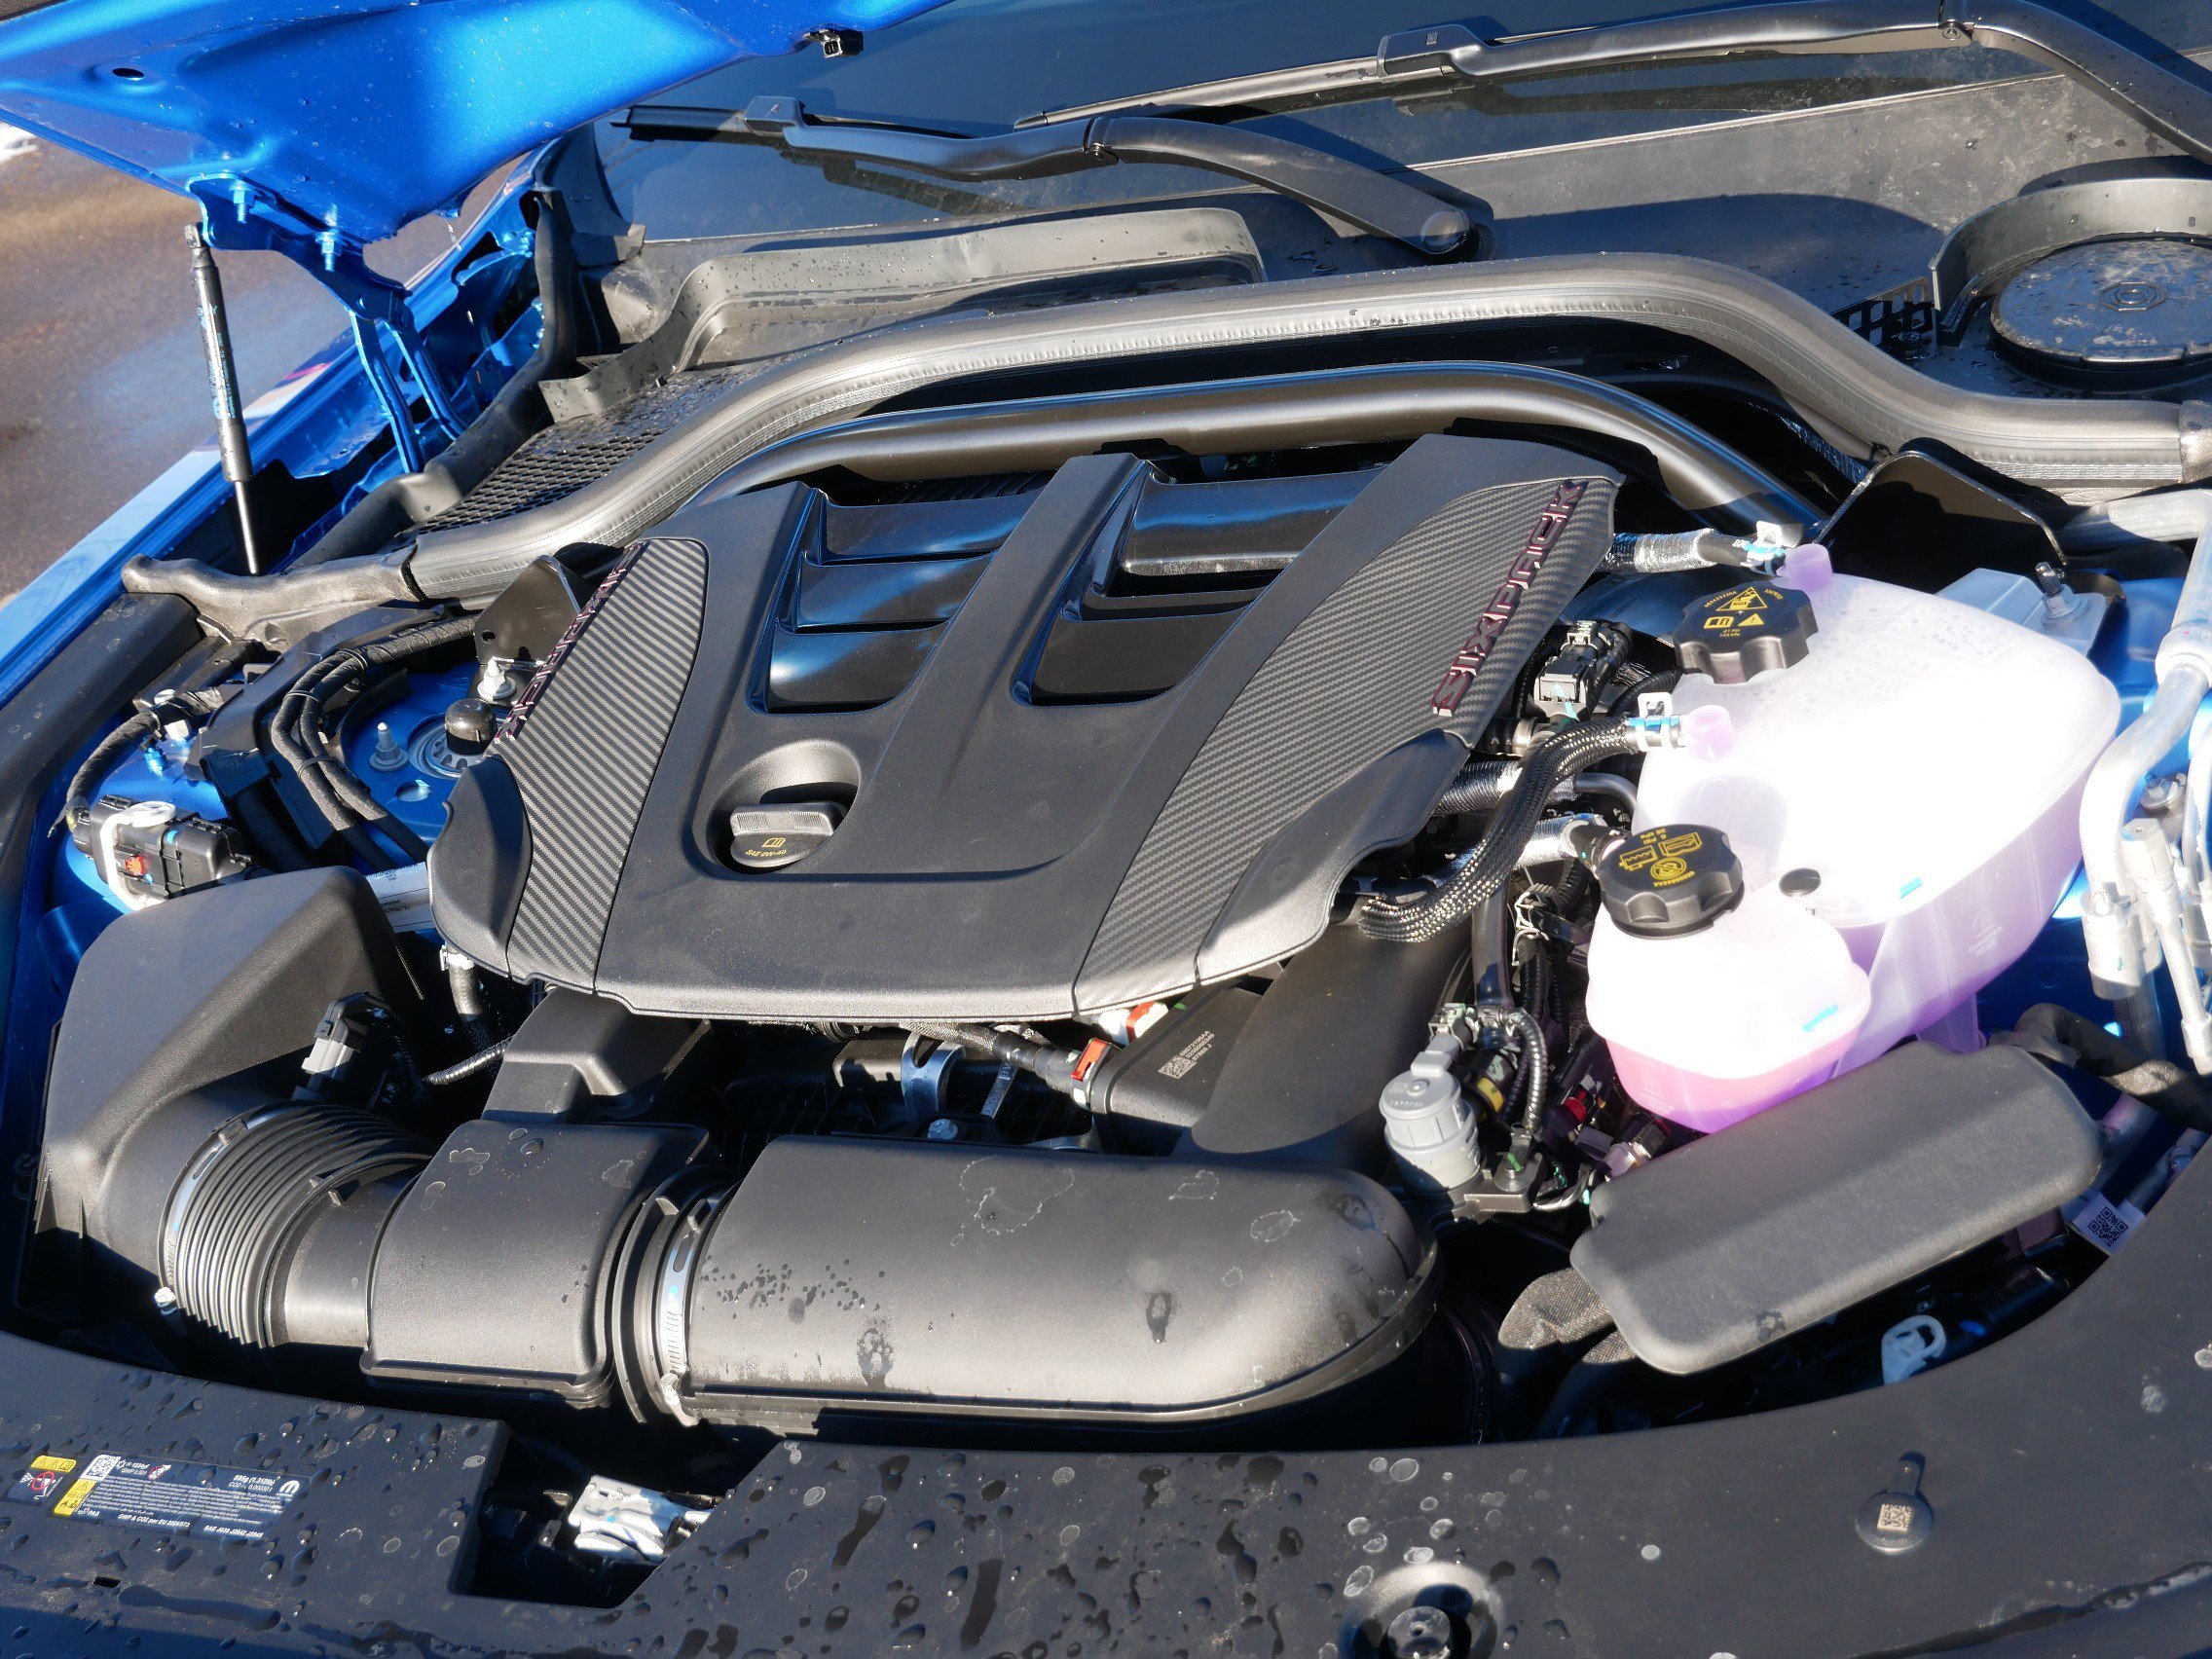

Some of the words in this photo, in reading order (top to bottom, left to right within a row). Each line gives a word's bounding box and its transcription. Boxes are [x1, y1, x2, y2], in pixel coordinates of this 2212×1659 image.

[1431, 479, 1588, 717] SIXPACK
[745, 849, 761, 858] SAE
[759, 849, 787, 858] 0W-40
